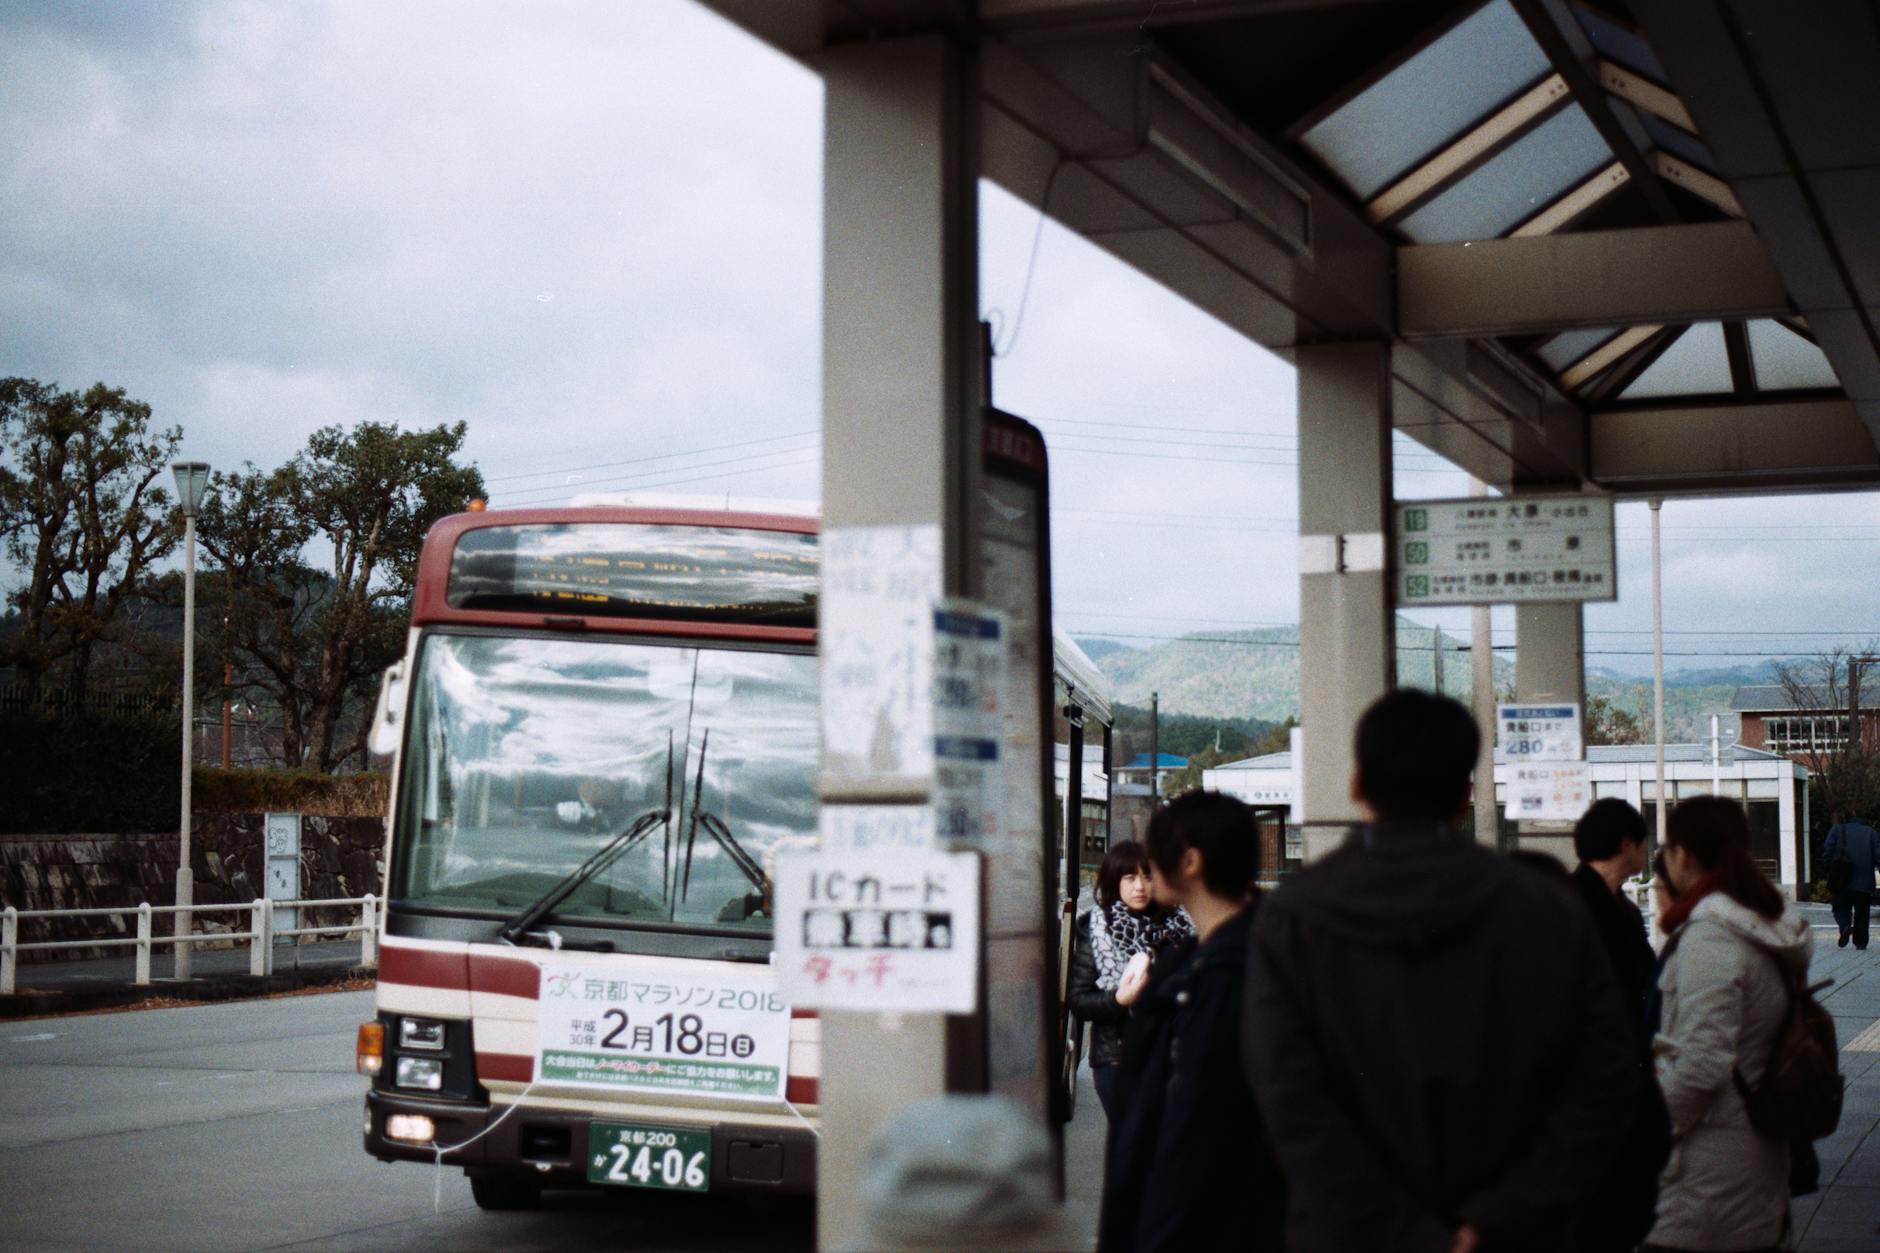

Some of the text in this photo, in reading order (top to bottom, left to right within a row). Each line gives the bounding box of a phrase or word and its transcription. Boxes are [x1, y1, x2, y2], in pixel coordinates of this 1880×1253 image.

[1407, 543, 1426, 562] 50
[1408, 576, 1427, 595] 52
[808, 868, 948, 903] ICカード
[803, 952, 895, 987] タッチ
[570, 1019, 597, 1033] 平成
[569, 1033, 597, 1047] 30年
[619, 1129, 677, 1147] 京都200
[608, 1143, 706, 1188] 24-06
